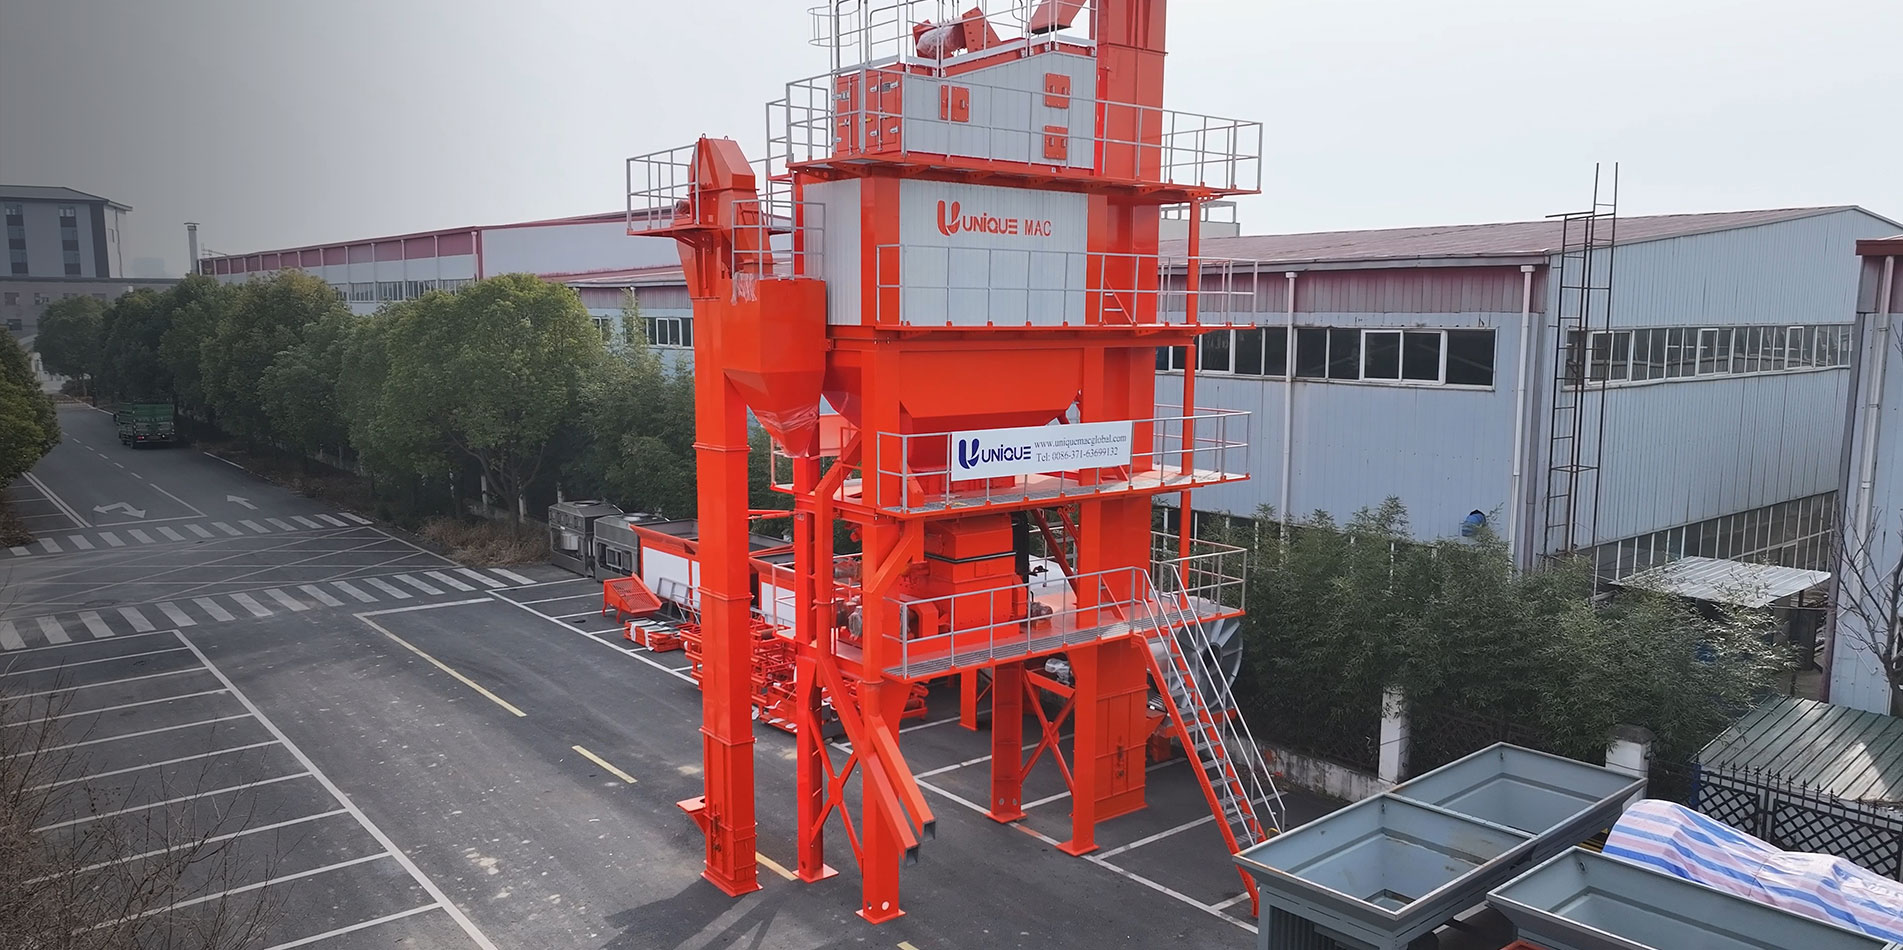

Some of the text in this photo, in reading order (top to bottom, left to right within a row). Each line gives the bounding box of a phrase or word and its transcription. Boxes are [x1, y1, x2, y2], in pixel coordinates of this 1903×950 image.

[1024, 219, 1051, 236] MAC
[1034, 434, 1127, 449] www.uniquemacglobal.com
[1036, 447, 1118, 463] Tel: 0086-371-63699132
